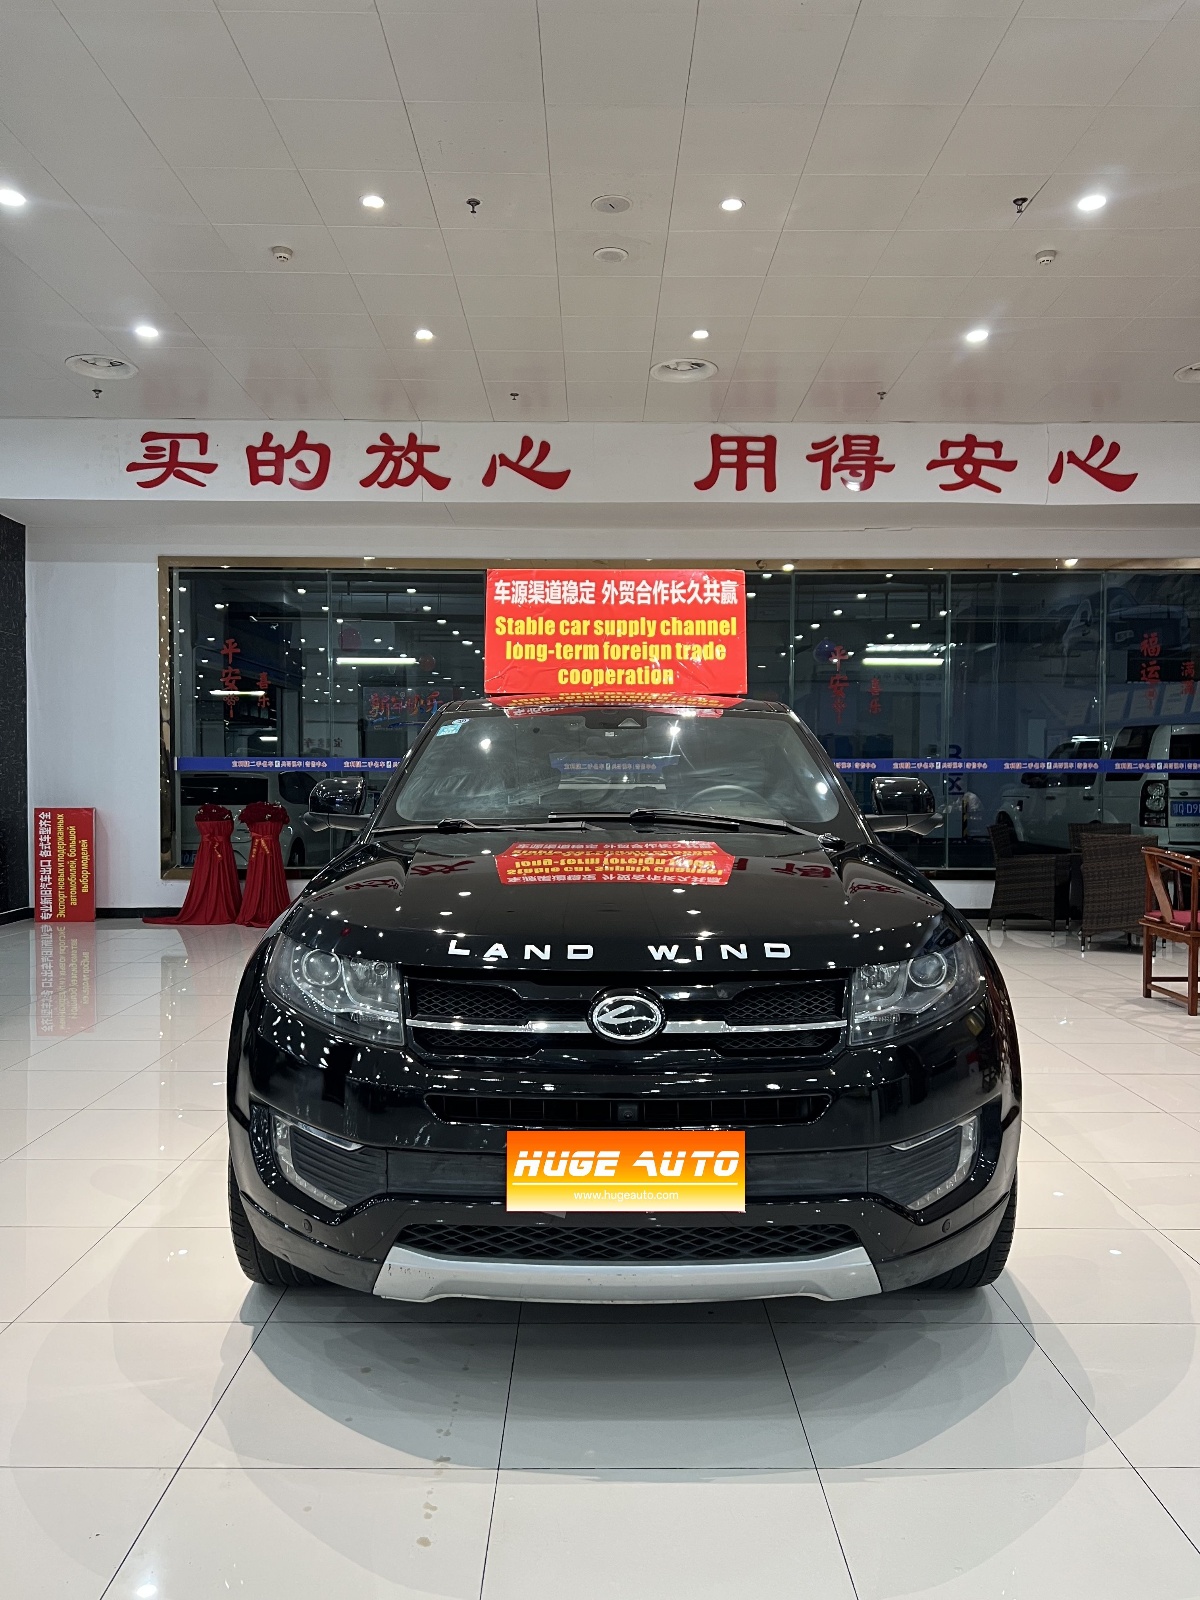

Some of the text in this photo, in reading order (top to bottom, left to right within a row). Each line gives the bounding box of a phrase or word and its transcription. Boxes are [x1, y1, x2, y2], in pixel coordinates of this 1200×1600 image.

[126, 430, 1137, 494] 买的放心 用得安心
[494, 579, 739, 606] 车源渠道稳定 外贸合作长久共赢
[495, 615, 737, 638] Stable car supply channel
[505, 640, 727, 662] long-term foreign trade
[557, 665, 675, 687] cooperation
[56, 813, 67, 861] подержанных
[67, 825, 78, 858] большой
[38, 811, 53, 921] 专业新旧汽车出口 各式车型齐全
[57, 868, 66, 890] новых
[79, 839, 91, 893] выбор моделей
[56, 890, 67, 919] Экспорт
[447, 939, 792, 961] LAND WIND
